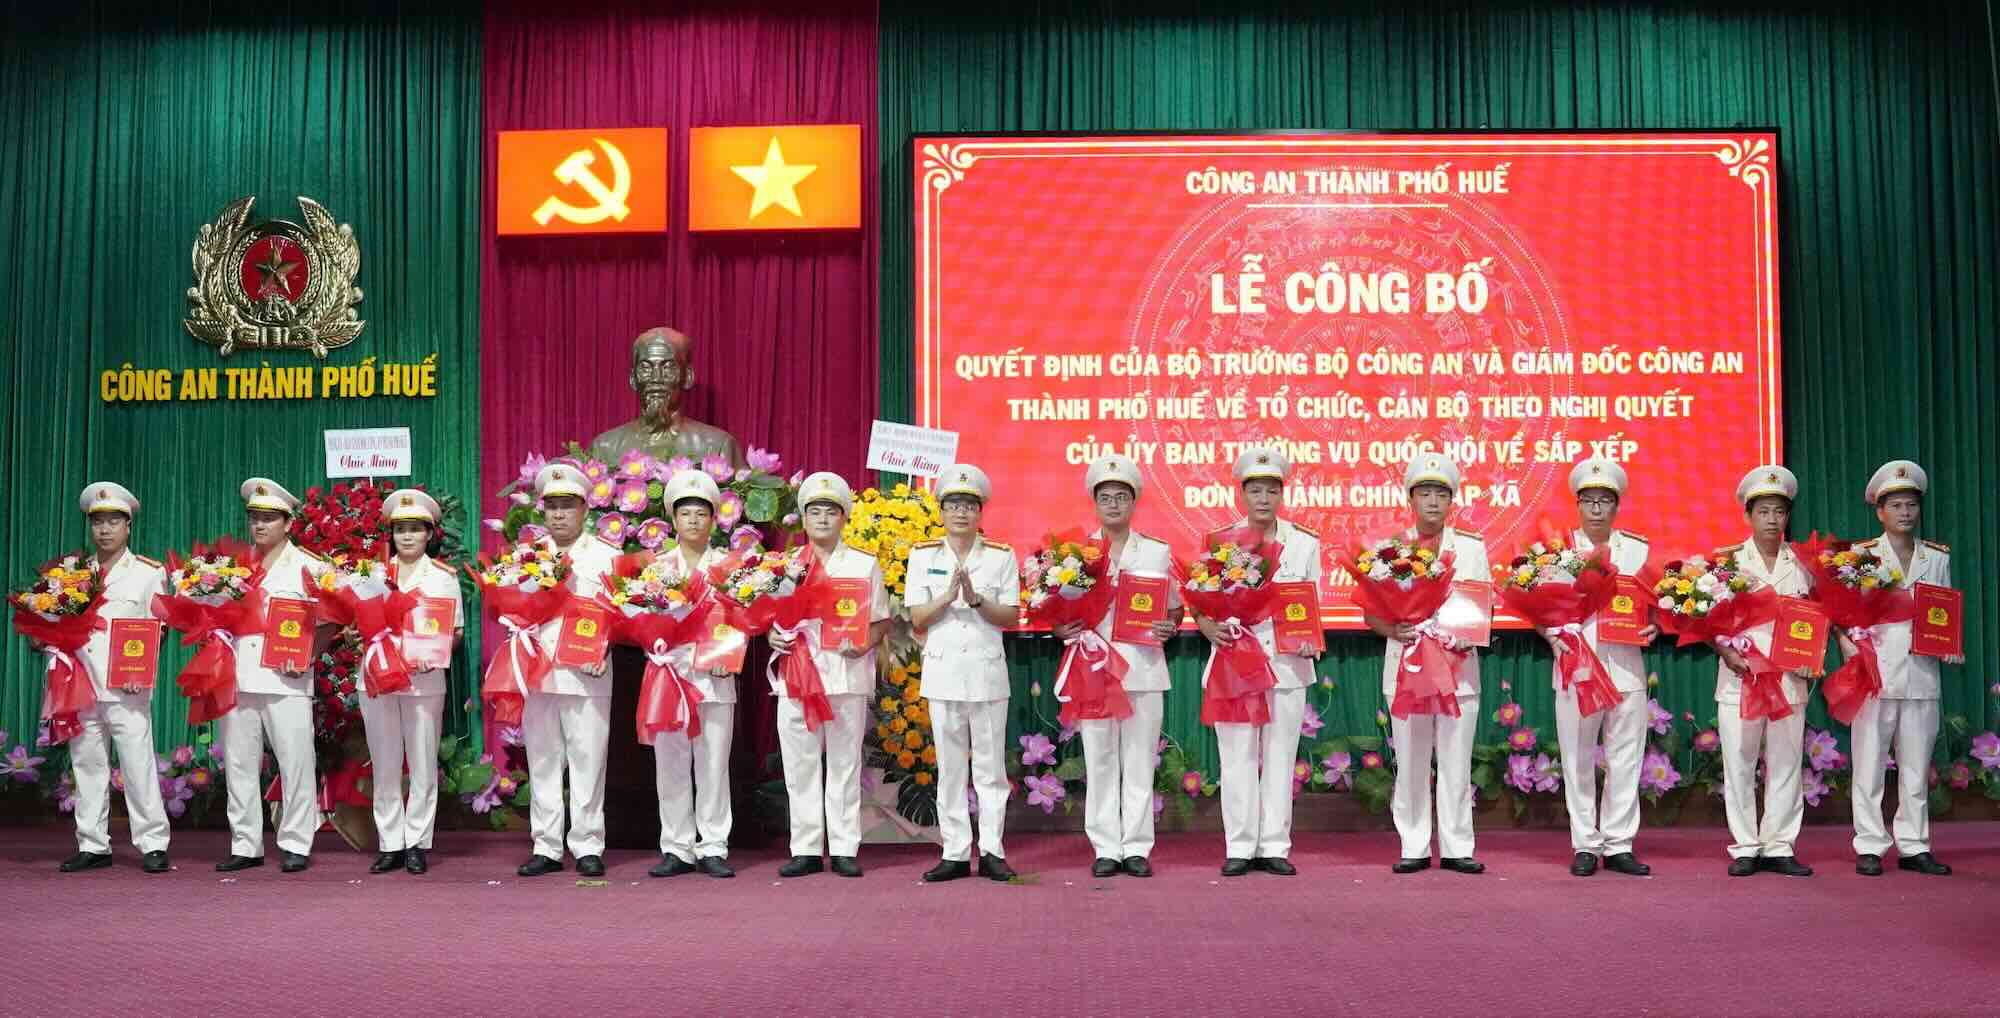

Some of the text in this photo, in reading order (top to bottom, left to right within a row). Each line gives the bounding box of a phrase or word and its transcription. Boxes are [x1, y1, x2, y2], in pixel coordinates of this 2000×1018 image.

[1186, 162, 1512, 194] CÔNG AN THÀNH PHỐ HUẾ
[1211, 253, 1495, 314] LỄ CÔNG BỐ
[101, 353, 441, 401] CÔNG AN THÀNH PHỐ HUẾ
[955, 344, 1744, 381] QUYẾT ĐỊNH CỦA BỘ TRƯỞNG BỘ CÔNG AN VÀ GIÁM ĐỐC CÔNG AN
[1007, 386, 1695, 424] THÀNH PHỐ HUẾ VỀ TỔ CHỨC, CÁN BỘ THEO NGHỊ QUYẾT
[1124, 434, 1157, 464] ỦY
[1165, 441, 1216, 464] BAN
[1327, 440, 1361, 468] VỤ
[1444, 434, 1487, 467] HỘI
[1494, 431, 1525, 463] VỀ
[1535, 432, 1583, 463] SẮP
[1590, 432, 1639, 463] XẾP
[1184, 481, 1236, 508] ĐƠN
[1350, 480, 1408, 508] CHÍN
[1452, 476, 1482, 507] ẤP
[1489, 480, 1521, 507] XÃ
